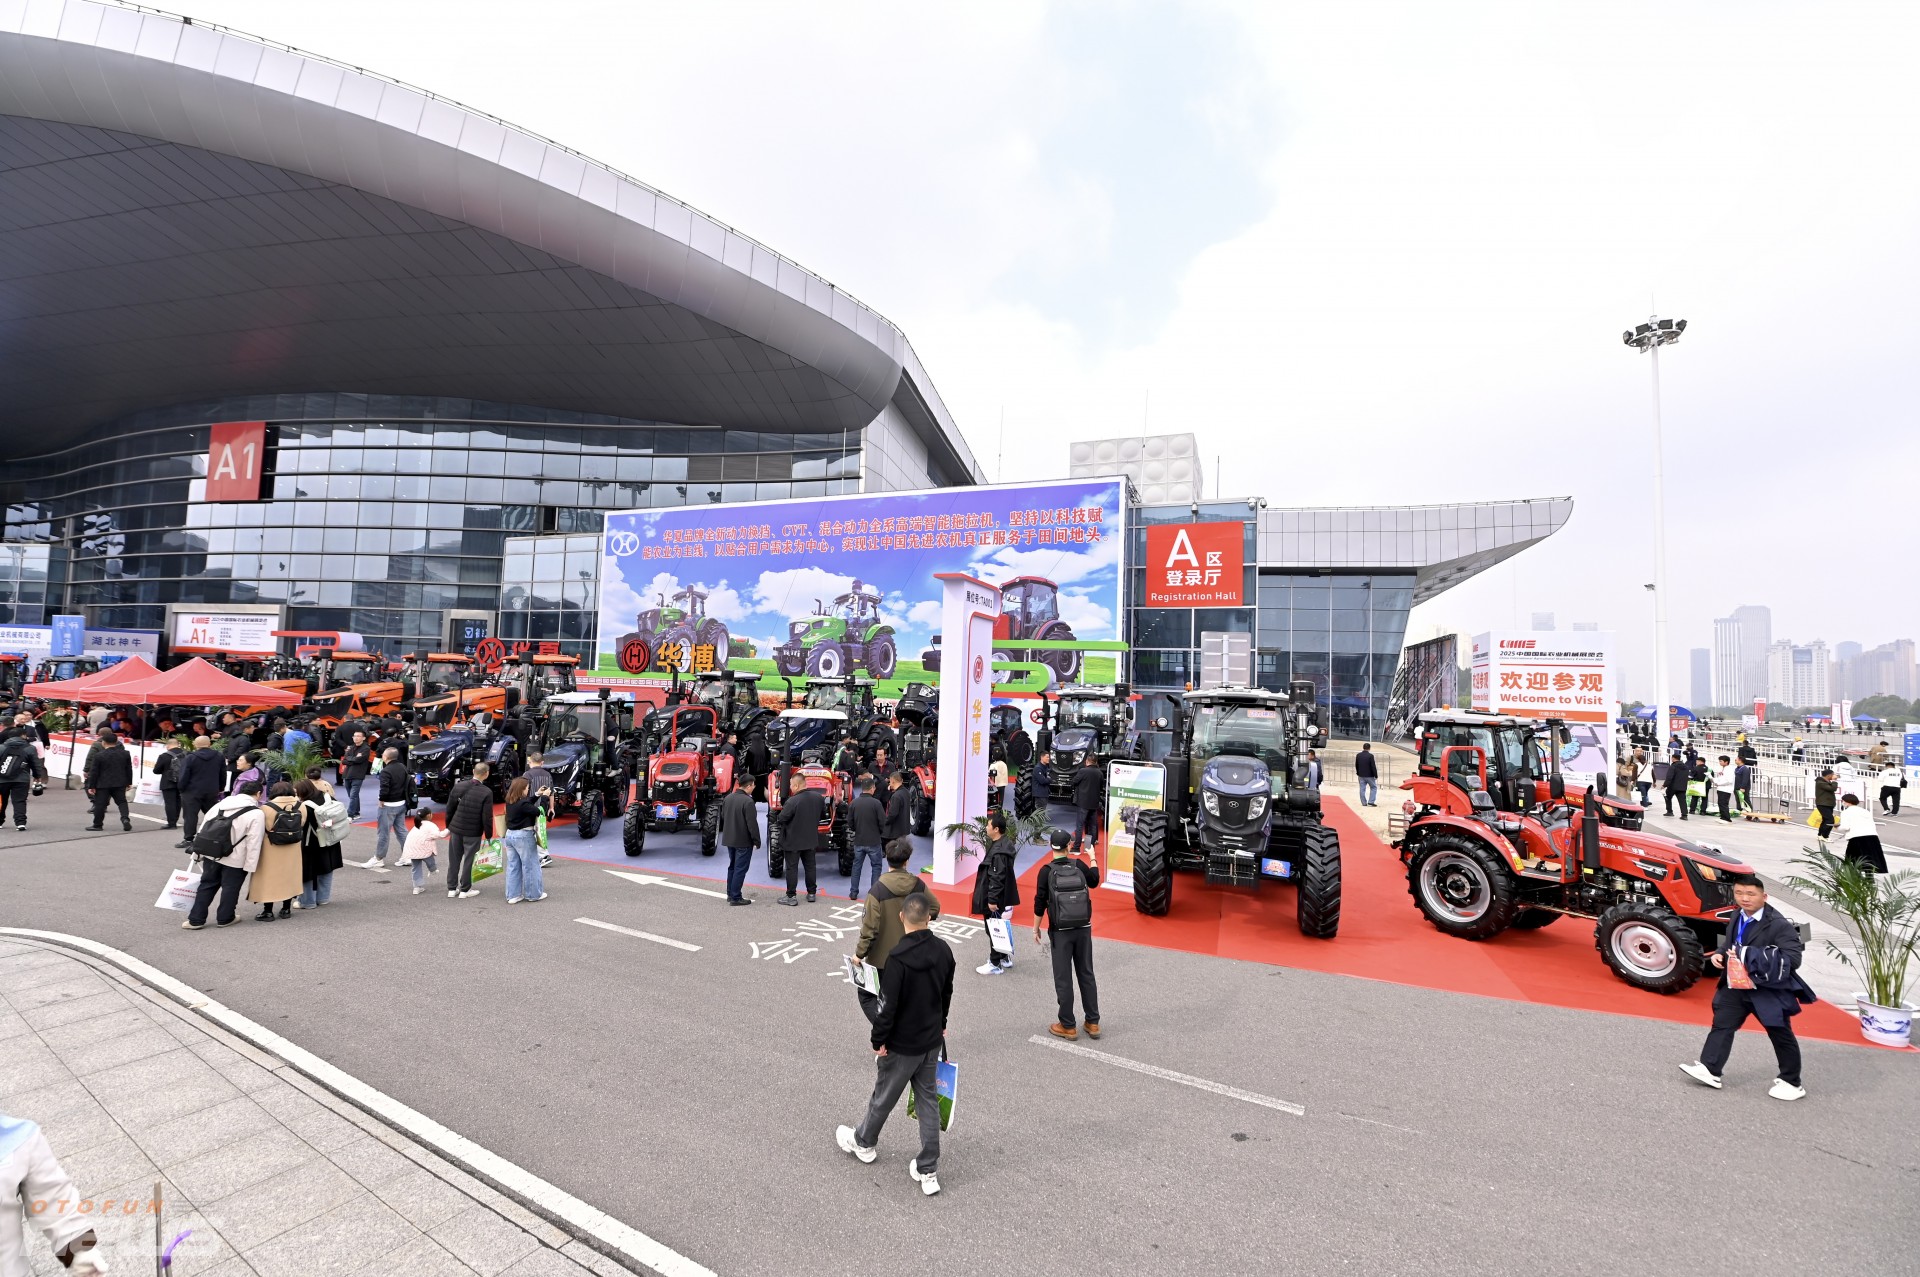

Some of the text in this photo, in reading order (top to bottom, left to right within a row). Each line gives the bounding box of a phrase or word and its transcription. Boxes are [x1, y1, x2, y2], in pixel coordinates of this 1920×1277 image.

[214, 443, 255, 480] A1
[1166, 570, 1221, 586] 登录厅
[1151, 591, 1237, 602] Registration Hall
[91, 635, 142, 648] 湖北神牛
[657, 642, 715, 674] 华博
[1500, 671, 1603, 692] 欢迎参观
[1500, 693, 1603, 705] Welcome to Visit
